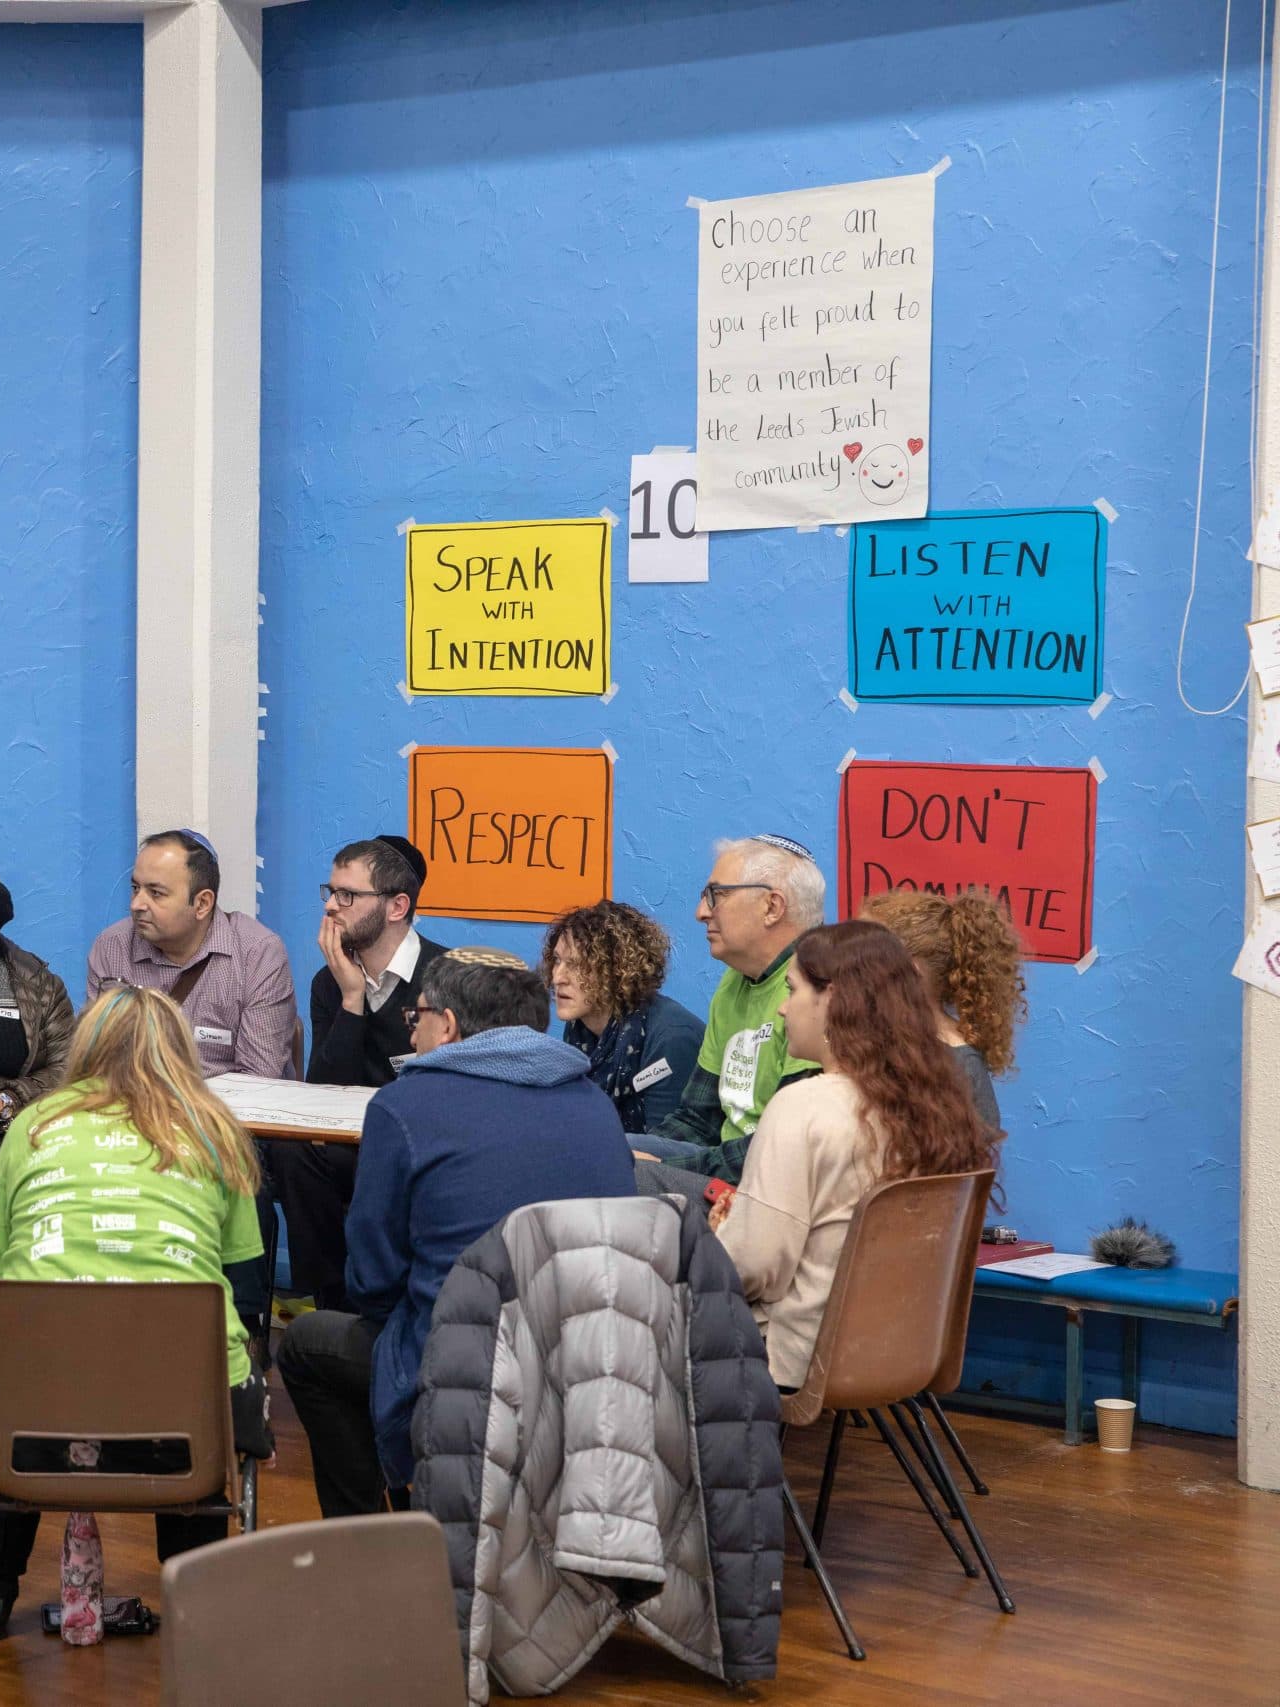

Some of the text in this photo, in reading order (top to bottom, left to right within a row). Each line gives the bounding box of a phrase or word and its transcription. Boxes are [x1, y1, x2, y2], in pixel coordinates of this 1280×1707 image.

[844, 208, 877, 235] an
[721, 238, 916, 291] experience when
[709, 290, 920, 348] you felt proud to
[709, 353, 900, 394] be a member of
[706, 398, 889, 442] the Leeds Jewish
[630, 479, 697, 540] 10
[433, 544, 554, 593] SPEAK
[868, 534, 1050, 578] LISTEN
[482, 601, 534, 620] WITH
[934, 594, 1011, 617] WITH
[425, 629, 594, 672] INTENTION
[874, 627, 1087, 673] ATTENTION
[429, 786, 596, 878] RESPECT
[881, 788, 1046, 851] DON'T
